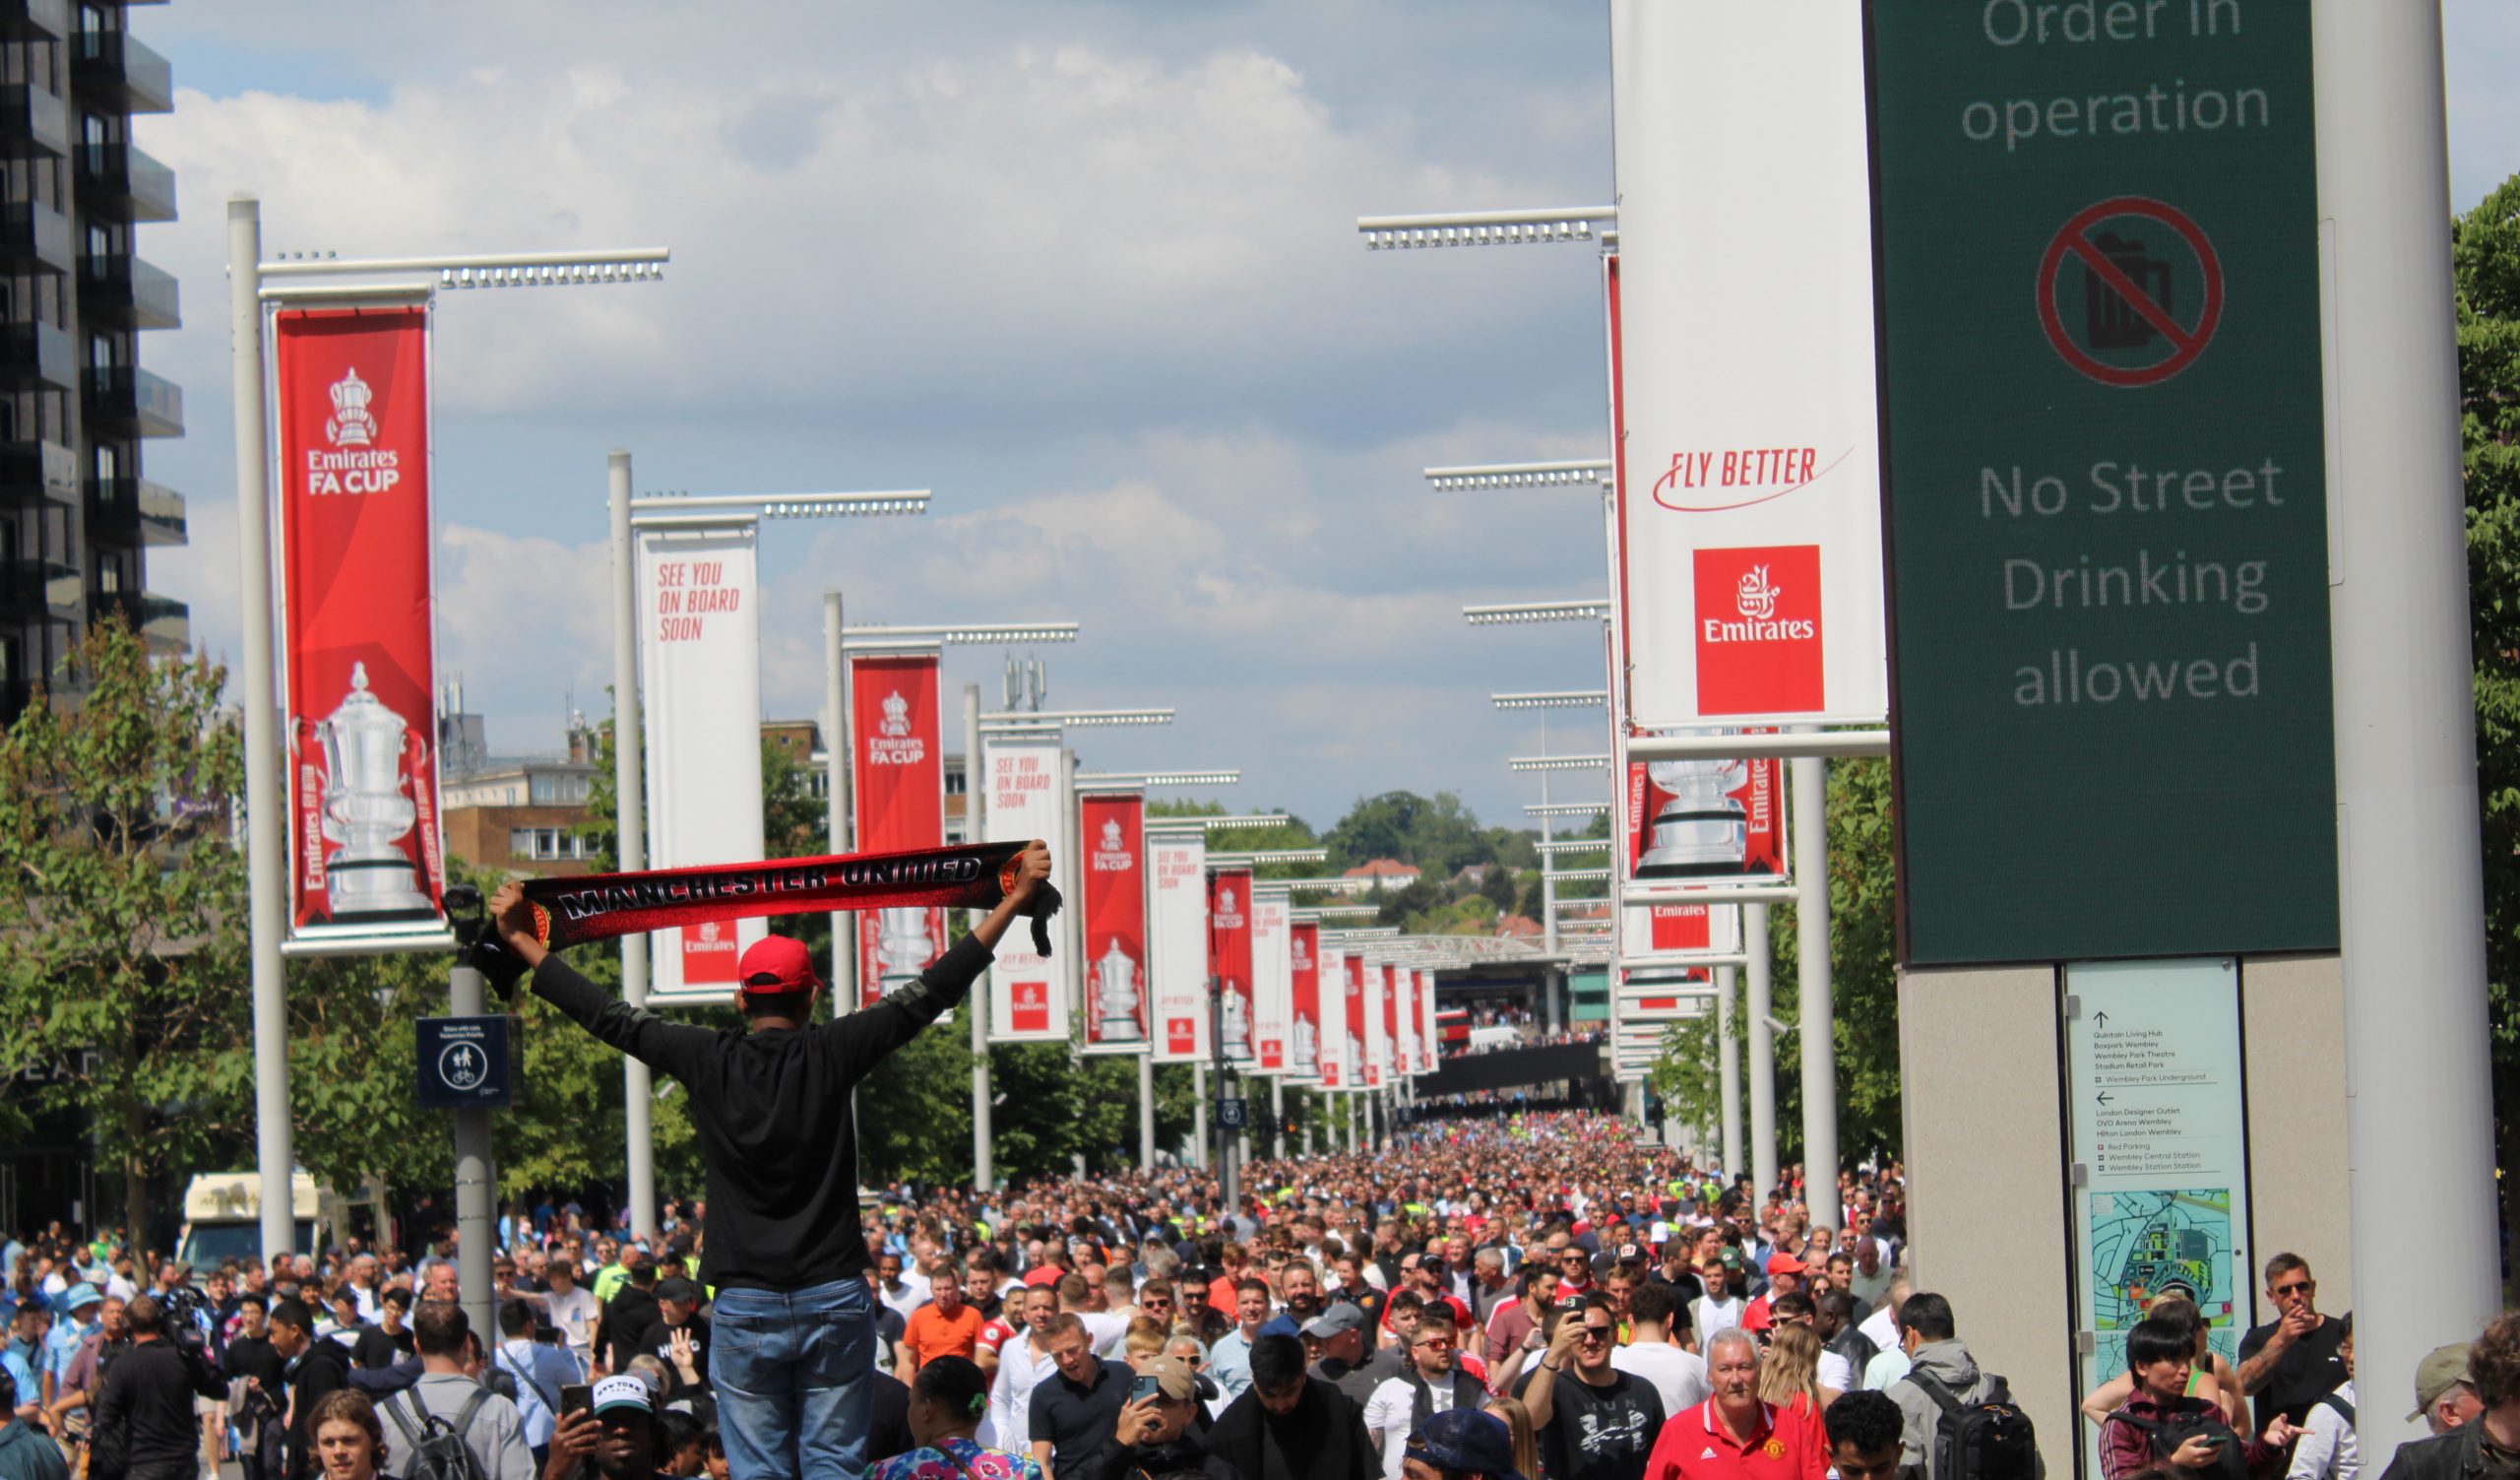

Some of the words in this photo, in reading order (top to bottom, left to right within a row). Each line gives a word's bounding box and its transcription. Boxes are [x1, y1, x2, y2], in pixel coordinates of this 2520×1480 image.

[1984, 0, 2167, 46] Order
[1962, 79, 2268, 151] operation
[308, 448, 398, 471] Emirates
[1670, 452, 1713, 488] FLY
[1722, 448, 1815, 486] BETTER
[309, 473, 342, 494] FA
[345, 470, 400, 492] CUP
[1981, 466, 2067, 518] No
[2090, 458, 2284, 513] Street
[659, 563, 686, 587] SEE
[693, 562, 722, 586] YOU
[2004, 549, 2269, 613] Drinking
[660, 591, 680, 614] ON
[687, 589, 739, 612] BOARD
[660, 617, 702, 641] SOON
[1704, 617, 1814, 642] Emirates
[2015, 641, 2259, 705] allowed
[869, 738, 923, 750] Emirates
[870, 751, 890, 764] FA
[892, 749, 923, 764] CUP
[996, 757, 1014, 773] SEE
[1019, 756, 1040, 772] YOU
[997, 776, 1011, 791] ON
[1016, 774, 1050, 790] BOARD
[997, 793, 1026, 808] SOON
[1629, 774, 1644, 833] Emirates
[305, 812, 325, 890] Emirates
[422, 823, 442, 882] Emirates
[558, 867, 827, 921] MANCHESTER
[842, 857, 981, 887] UNITED
[1655, 905, 1705, 917] Emirates
[685, 940, 735, 953] Emirates
[2159, 1073, 2206, 1082] Underground
[2110, 1163, 2143, 1172] Wembley
[597, 1383, 614, 1396] NEW
[616, 1382, 641, 1392] YORK
